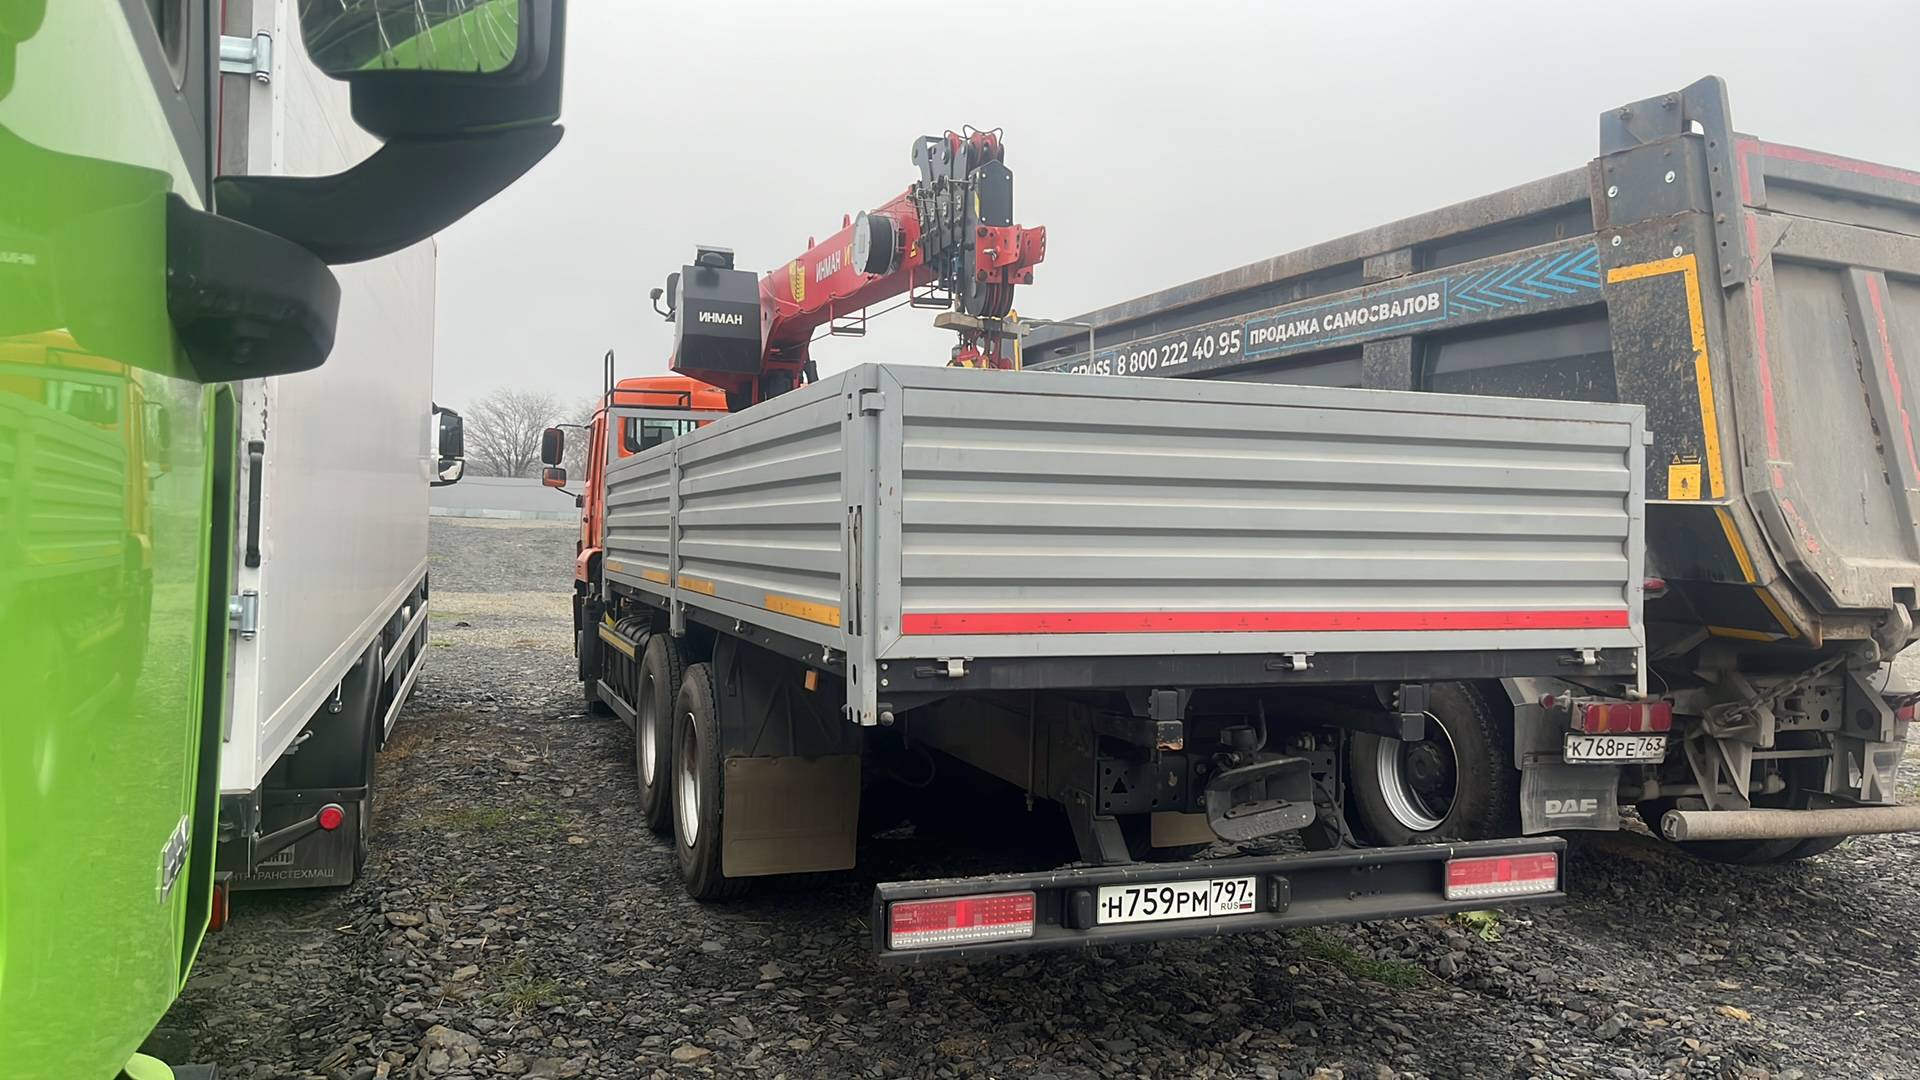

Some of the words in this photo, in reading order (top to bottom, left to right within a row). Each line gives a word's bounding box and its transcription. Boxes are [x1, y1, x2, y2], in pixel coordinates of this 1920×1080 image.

[816, 250, 841, 283] ИНМАН
[699, 311, 743, 325] ИНМАН
[1250, 319, 1320, 345] ПРОДАЖА
[1323, 292, 1440, 331] САМОСВАЛОВ
[1117, 355, 1126, 375] 8
[1129, 348, 1158, 373] 800
[1160, 341, 1188, 368] 222
[1192, 335, 1215, 360] 40
[1218, 329, 1241, 355] 95
[1639, 738, 1661, 752] 763
[1545, 798, 1598, 813] DAF
[1108, 887, 1208, 918] Н759РМ
[1212, 880, 1249, 903] 797
[1220, 901, 1239, 910] RUS
